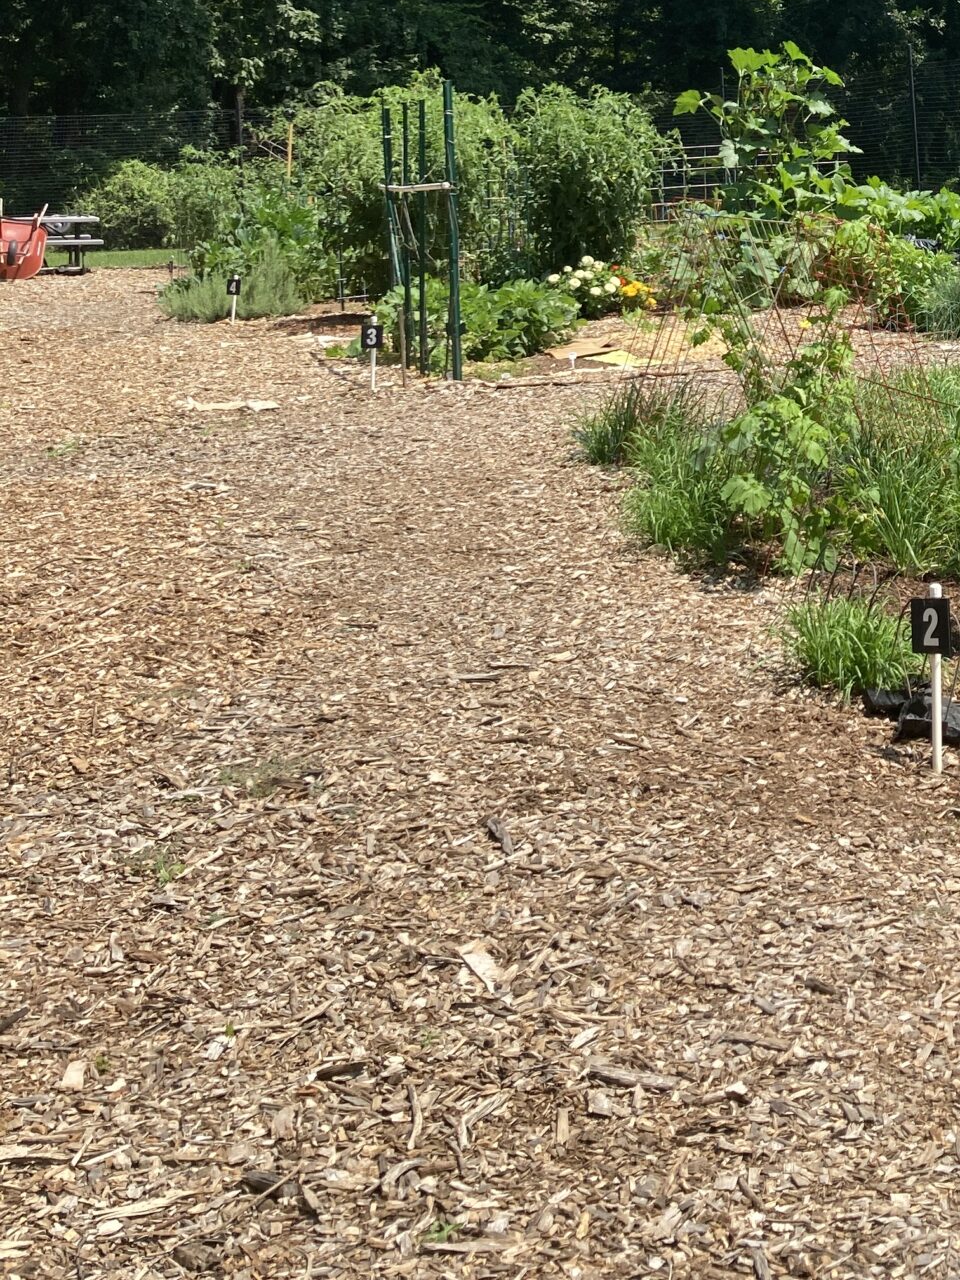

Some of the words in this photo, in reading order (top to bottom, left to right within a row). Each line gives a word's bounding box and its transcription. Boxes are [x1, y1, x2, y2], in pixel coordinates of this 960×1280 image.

[230, 281, 237, 293] 4
[366, 328, 377, 345] 3
[922, 607, 940, 647] 2
